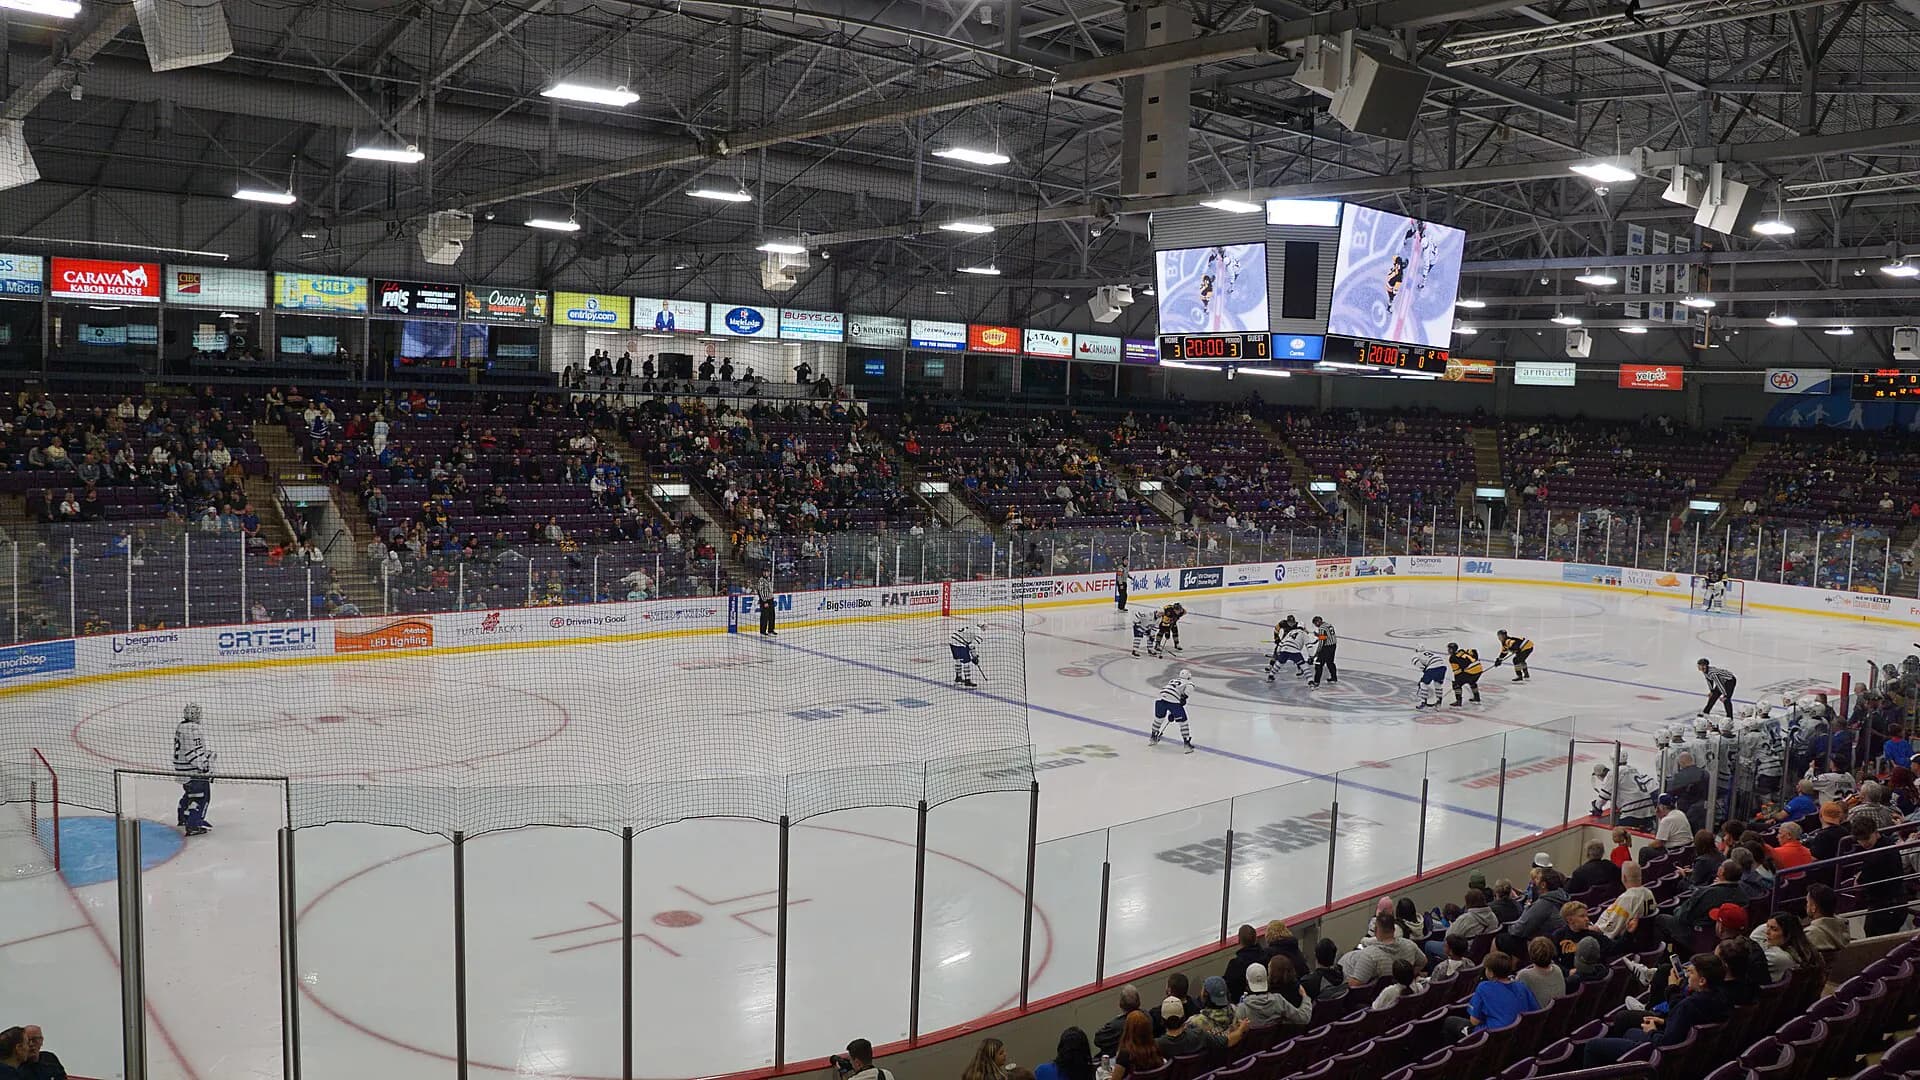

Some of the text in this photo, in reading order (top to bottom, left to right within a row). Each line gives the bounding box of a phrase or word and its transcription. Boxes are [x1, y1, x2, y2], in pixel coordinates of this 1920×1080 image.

[63, 271, 136, 287] CARAVAN
[178, 273, 200, 283] CIBC
[6, 281, 40, 294] Media
[70, 285, 142, 296] KABOB HOUSE
[316, 279, 350, 294] SHER
[488, 289, 527, 306] Oscar's
[569, 311, 615, 322] entripy.com
[784, 311, 839, 323] BUSYS.CA
[1040, 333, 1059, 346] TAXI
[1089, 343, 1117, 354] CANADIAN
[1174, 339, 1265, 358] 3 20:00 3 0
[1359, 349, 1365, 362] 3
[1369, 345, 1398, 365] 20:00
[1400, 354, 1406, 366] 3
[1418, 356, 1425, 369] 0
[1523, 368, 1571, 377] armacell
[1635, 371, 1657, 382] yelp
[1863, 374, 1869, 383] 3
[1910, 375, 1917, 383] 0
[1774, 373, 1795, 386] CAA
[1184, 571, 1198, 588] flo
[826, 598, 872, 611] BigSteelBox
[881, 592, 909, 607] FAT
[910, 597, 938, 605] BURRITO
[566, 615, 626, 626] Driven by Good
[125, 632, 179, 646] bergmanis
[218, 627, 316, 649] ORTECH
[370, 636, 427, 649] LED Lighting
